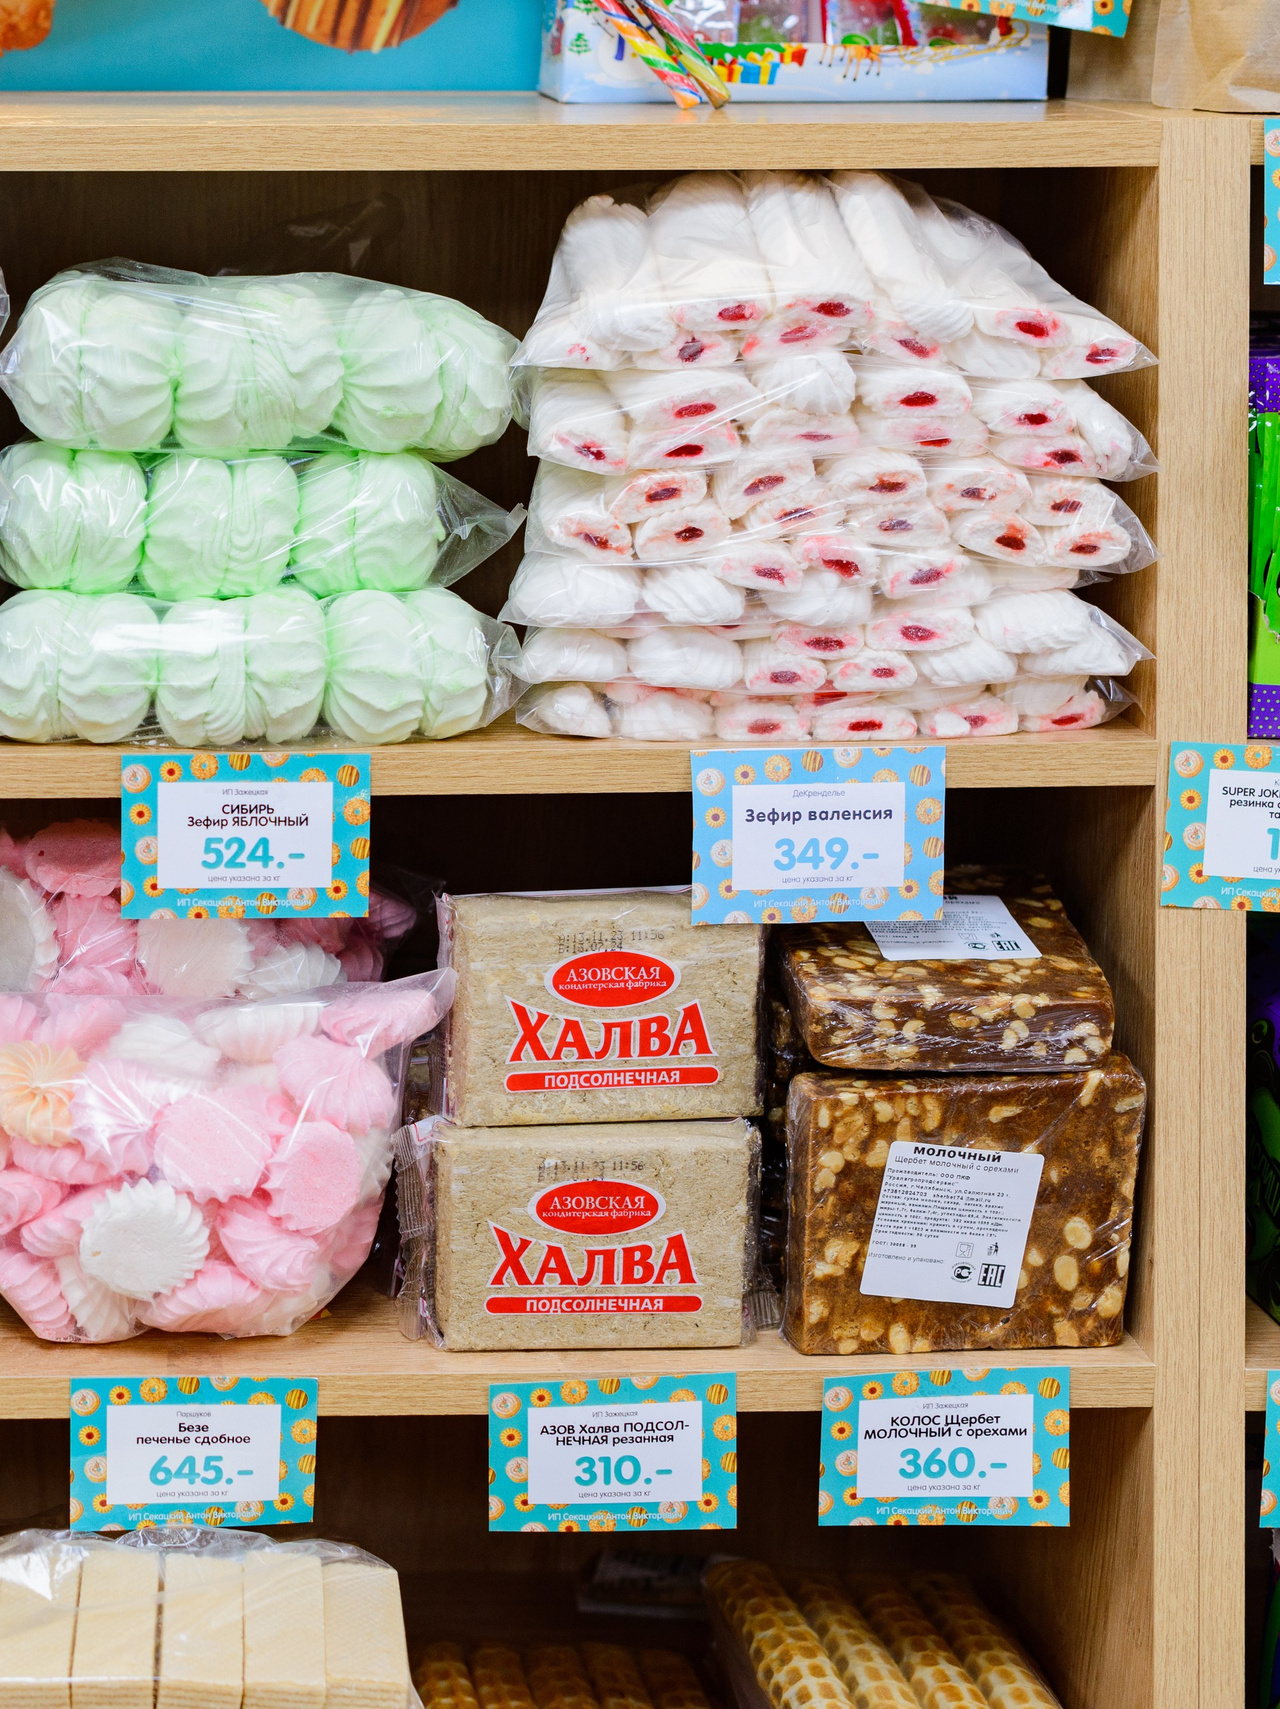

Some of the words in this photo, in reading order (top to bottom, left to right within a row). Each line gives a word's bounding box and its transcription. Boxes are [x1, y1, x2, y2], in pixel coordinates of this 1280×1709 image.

[793, 789, 845, 799] ДеКренделье
[1222, 786, 1255, 797] SUPER
[1258, 788, 1280, 798] JOK
[222, 804, 275, 814] СИБИРЬ
[1229, 799, 1274, 808] резинка
[187, 817, 228, 829] Зефир
[232, 814, 309, 826] ЯБЛОЧНЫЙ
[745, 809, 802, 825] Зефир
[808, 809, 893, 821] валенсия
[201, 837, 305, 869] 524.-
[773, 837, 879, 871] 349.-
[208, 875, 227, 883] цена
[229, 875, 260, 883] указана
[1221, 887, 1234, 896] ИП
[1236, 888, 1276, 898] Секацкий
[566, 966, 661, 982] АЗОВСКАЯ
[558, 981, 625, 991] кондитерская
[626, 979, 667, 990] фабрика
[505, 996, 718, 1064] ХАЛВА
[544, 1071, 680, 1089] ПОДСОЛНЕЧНАЯ
[914, 1146, 1002, 1163] молочный
[895, 1156, 927, 1165] Щербет
[930, 1160, 974, 1170] молочный
[984, 1165, 1019, 1174] орехами
[550, 1195, 645, 1210] АЗОВСКАЯ
[542, 1210, 609, 1219] кондитерская
[610, 1208, 652, 1219] фабрика
[487, 1222, 700, 1287] ХАЛВА
[526, 1299, 664, 1313] ПОДСОЛНЕЧНАЯ
[178, 1423, 209, 1432] Безе
[540, 1425, 575, 1435] АЗОВ
[579, 1424, 620, 1434] Халва
[624, 1420, 690, 1434] ПОДСОЛ-
[890, 1415, 940, 1427] КОЛОС
[945, 1414, 1001, 1426] Щербет
[864, 1424, 952, 1440] МОЛОЧНЫЙ
[956, 1429, 962, 1437] с
[966, 1427, 1027, 1438] орехами
[136, 1435, 190, 1445] печенье
[195, 1434, 251, 1445] сдобное
[556, 1435, 608, 1446] НЕЧНАЯ
[613, 1434, 674, 1446] резанная
[898, 1447, 1007, 1479] 360.-
[149, 1455, 253, 1486] 645.-
[575, 1455, 672, 1486] 310.-
[928, 1484, 960, 1492] указана
[548, 1513, 561, 1521] ИП
[563, 1513, 604, 1522] Секацкий
[606, 1512, 631, 1520] Антон
[633, 1512, 682, 1521] Викторович
[877, 1507, 890, 1515] ИП
[892, 1507, 933, 1516] Секацкий
[935, 1507, 960, 1515] Антон
[963, 1507, 1012, 1516] Викторович
